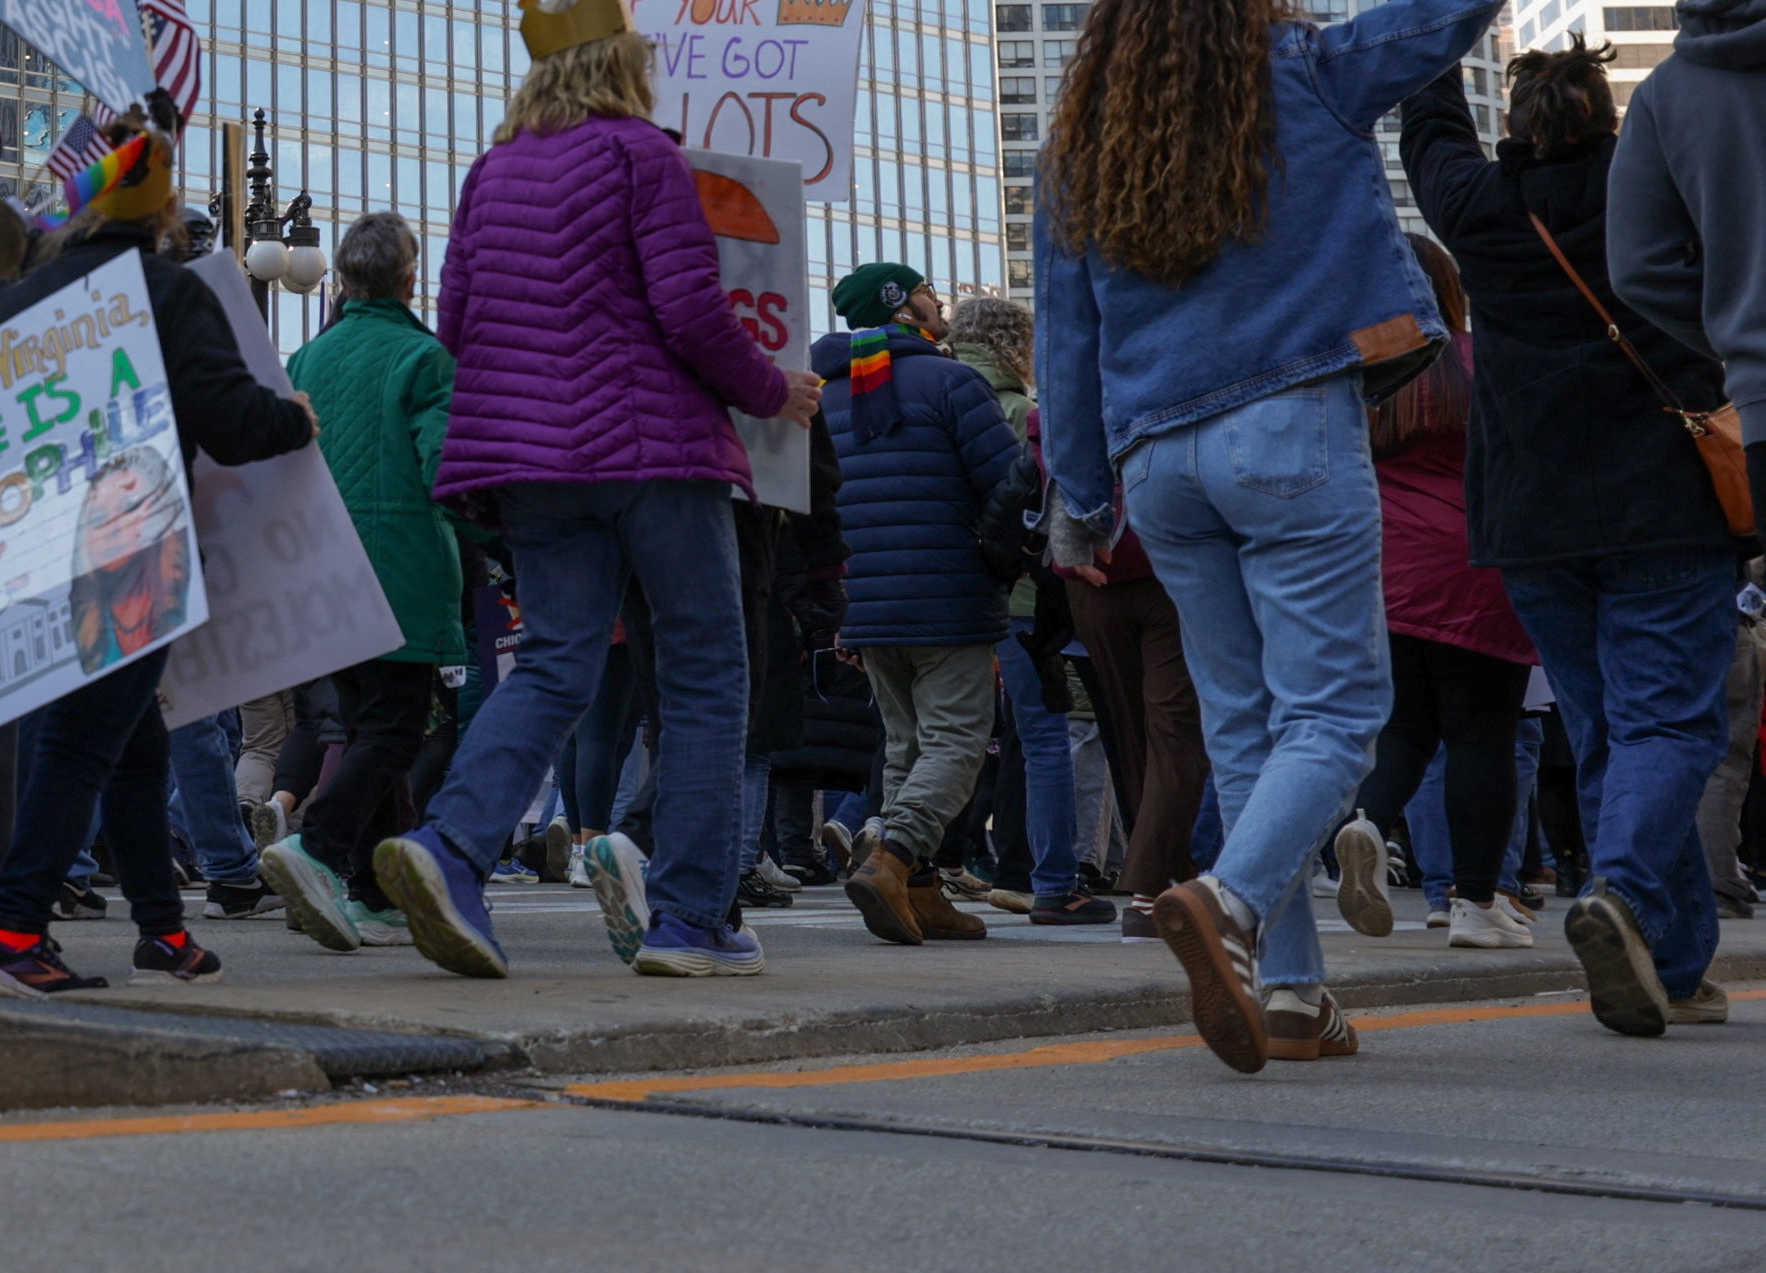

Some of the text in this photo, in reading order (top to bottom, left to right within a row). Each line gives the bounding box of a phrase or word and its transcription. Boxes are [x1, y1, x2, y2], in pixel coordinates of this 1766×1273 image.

[722, 36, 808, 80] GOT
[16, 372, 81, 442] IS
[110, 347, 141, 398] A
